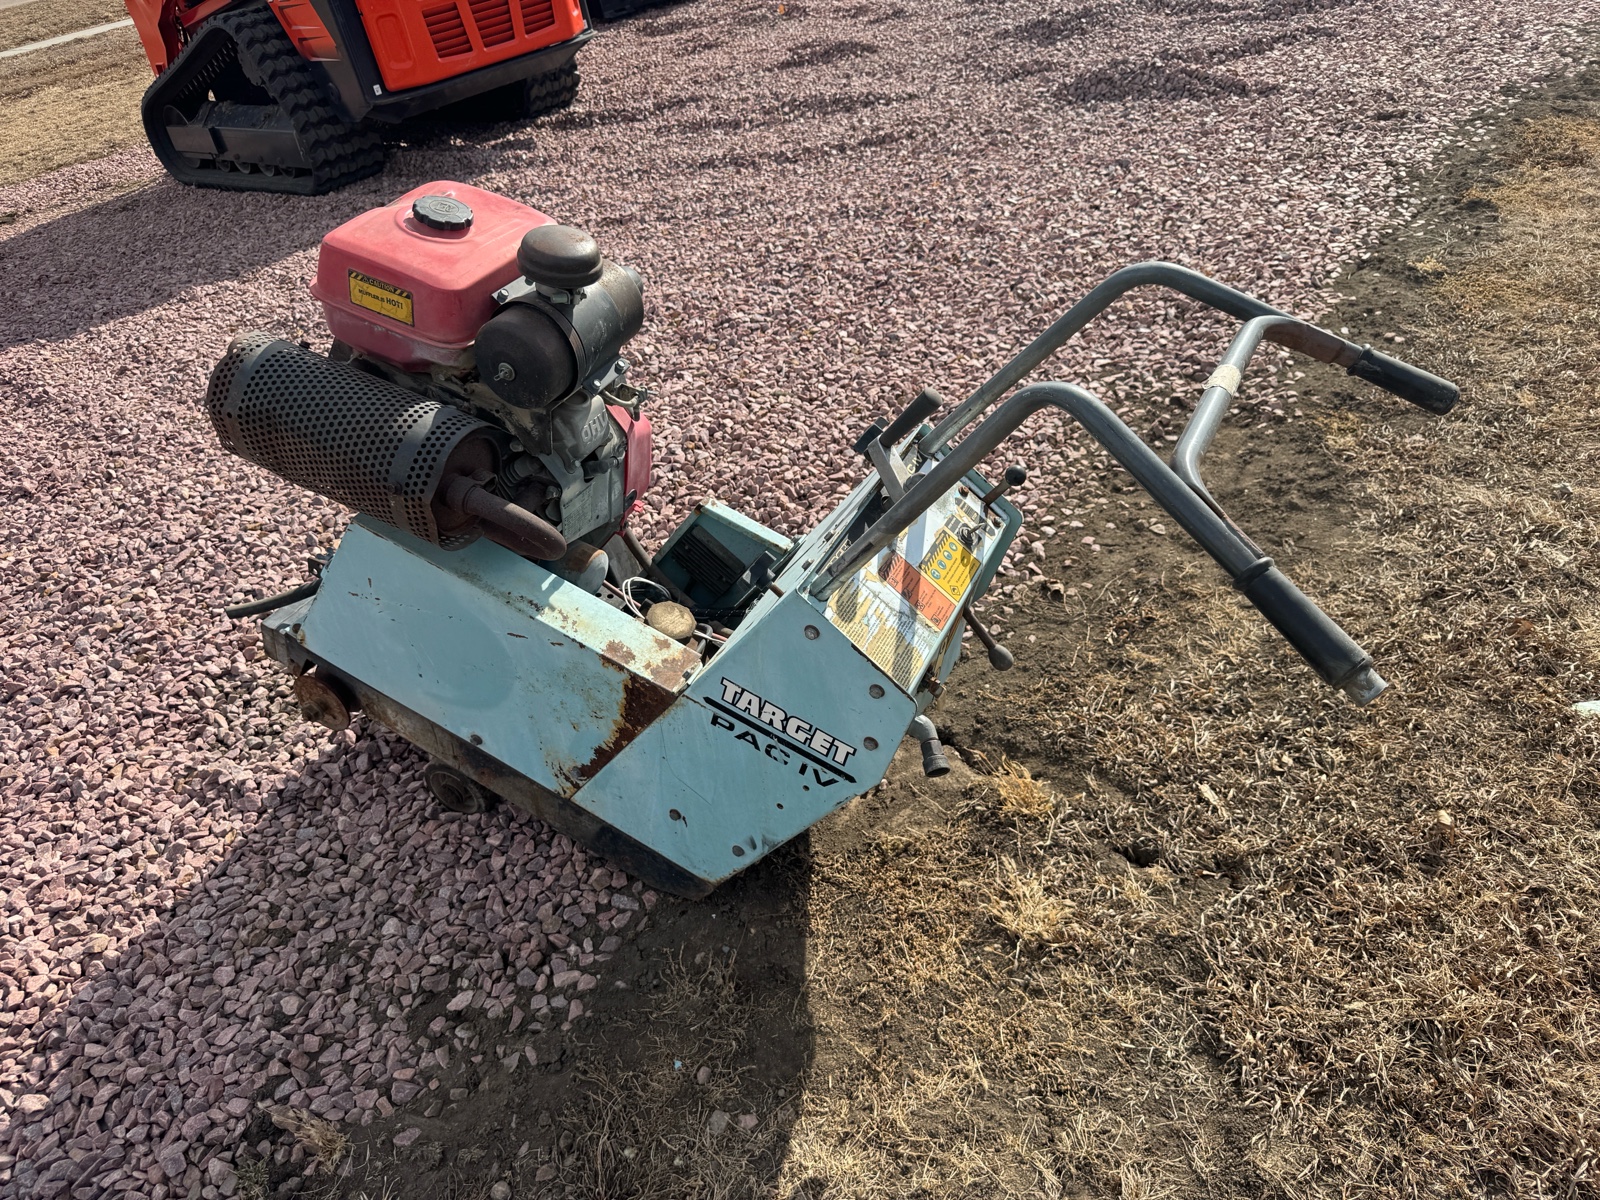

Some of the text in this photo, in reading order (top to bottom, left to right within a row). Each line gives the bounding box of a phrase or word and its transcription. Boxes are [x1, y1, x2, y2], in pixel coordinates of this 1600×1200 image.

[370, 279, 395, 293] CAUTION
[358, 289, 380, 301] MUFFLER
[386, 297, 403, 310] HOT!
[720, 676, 858, 767] TARGET
[798, 762, 840, 788] IV
